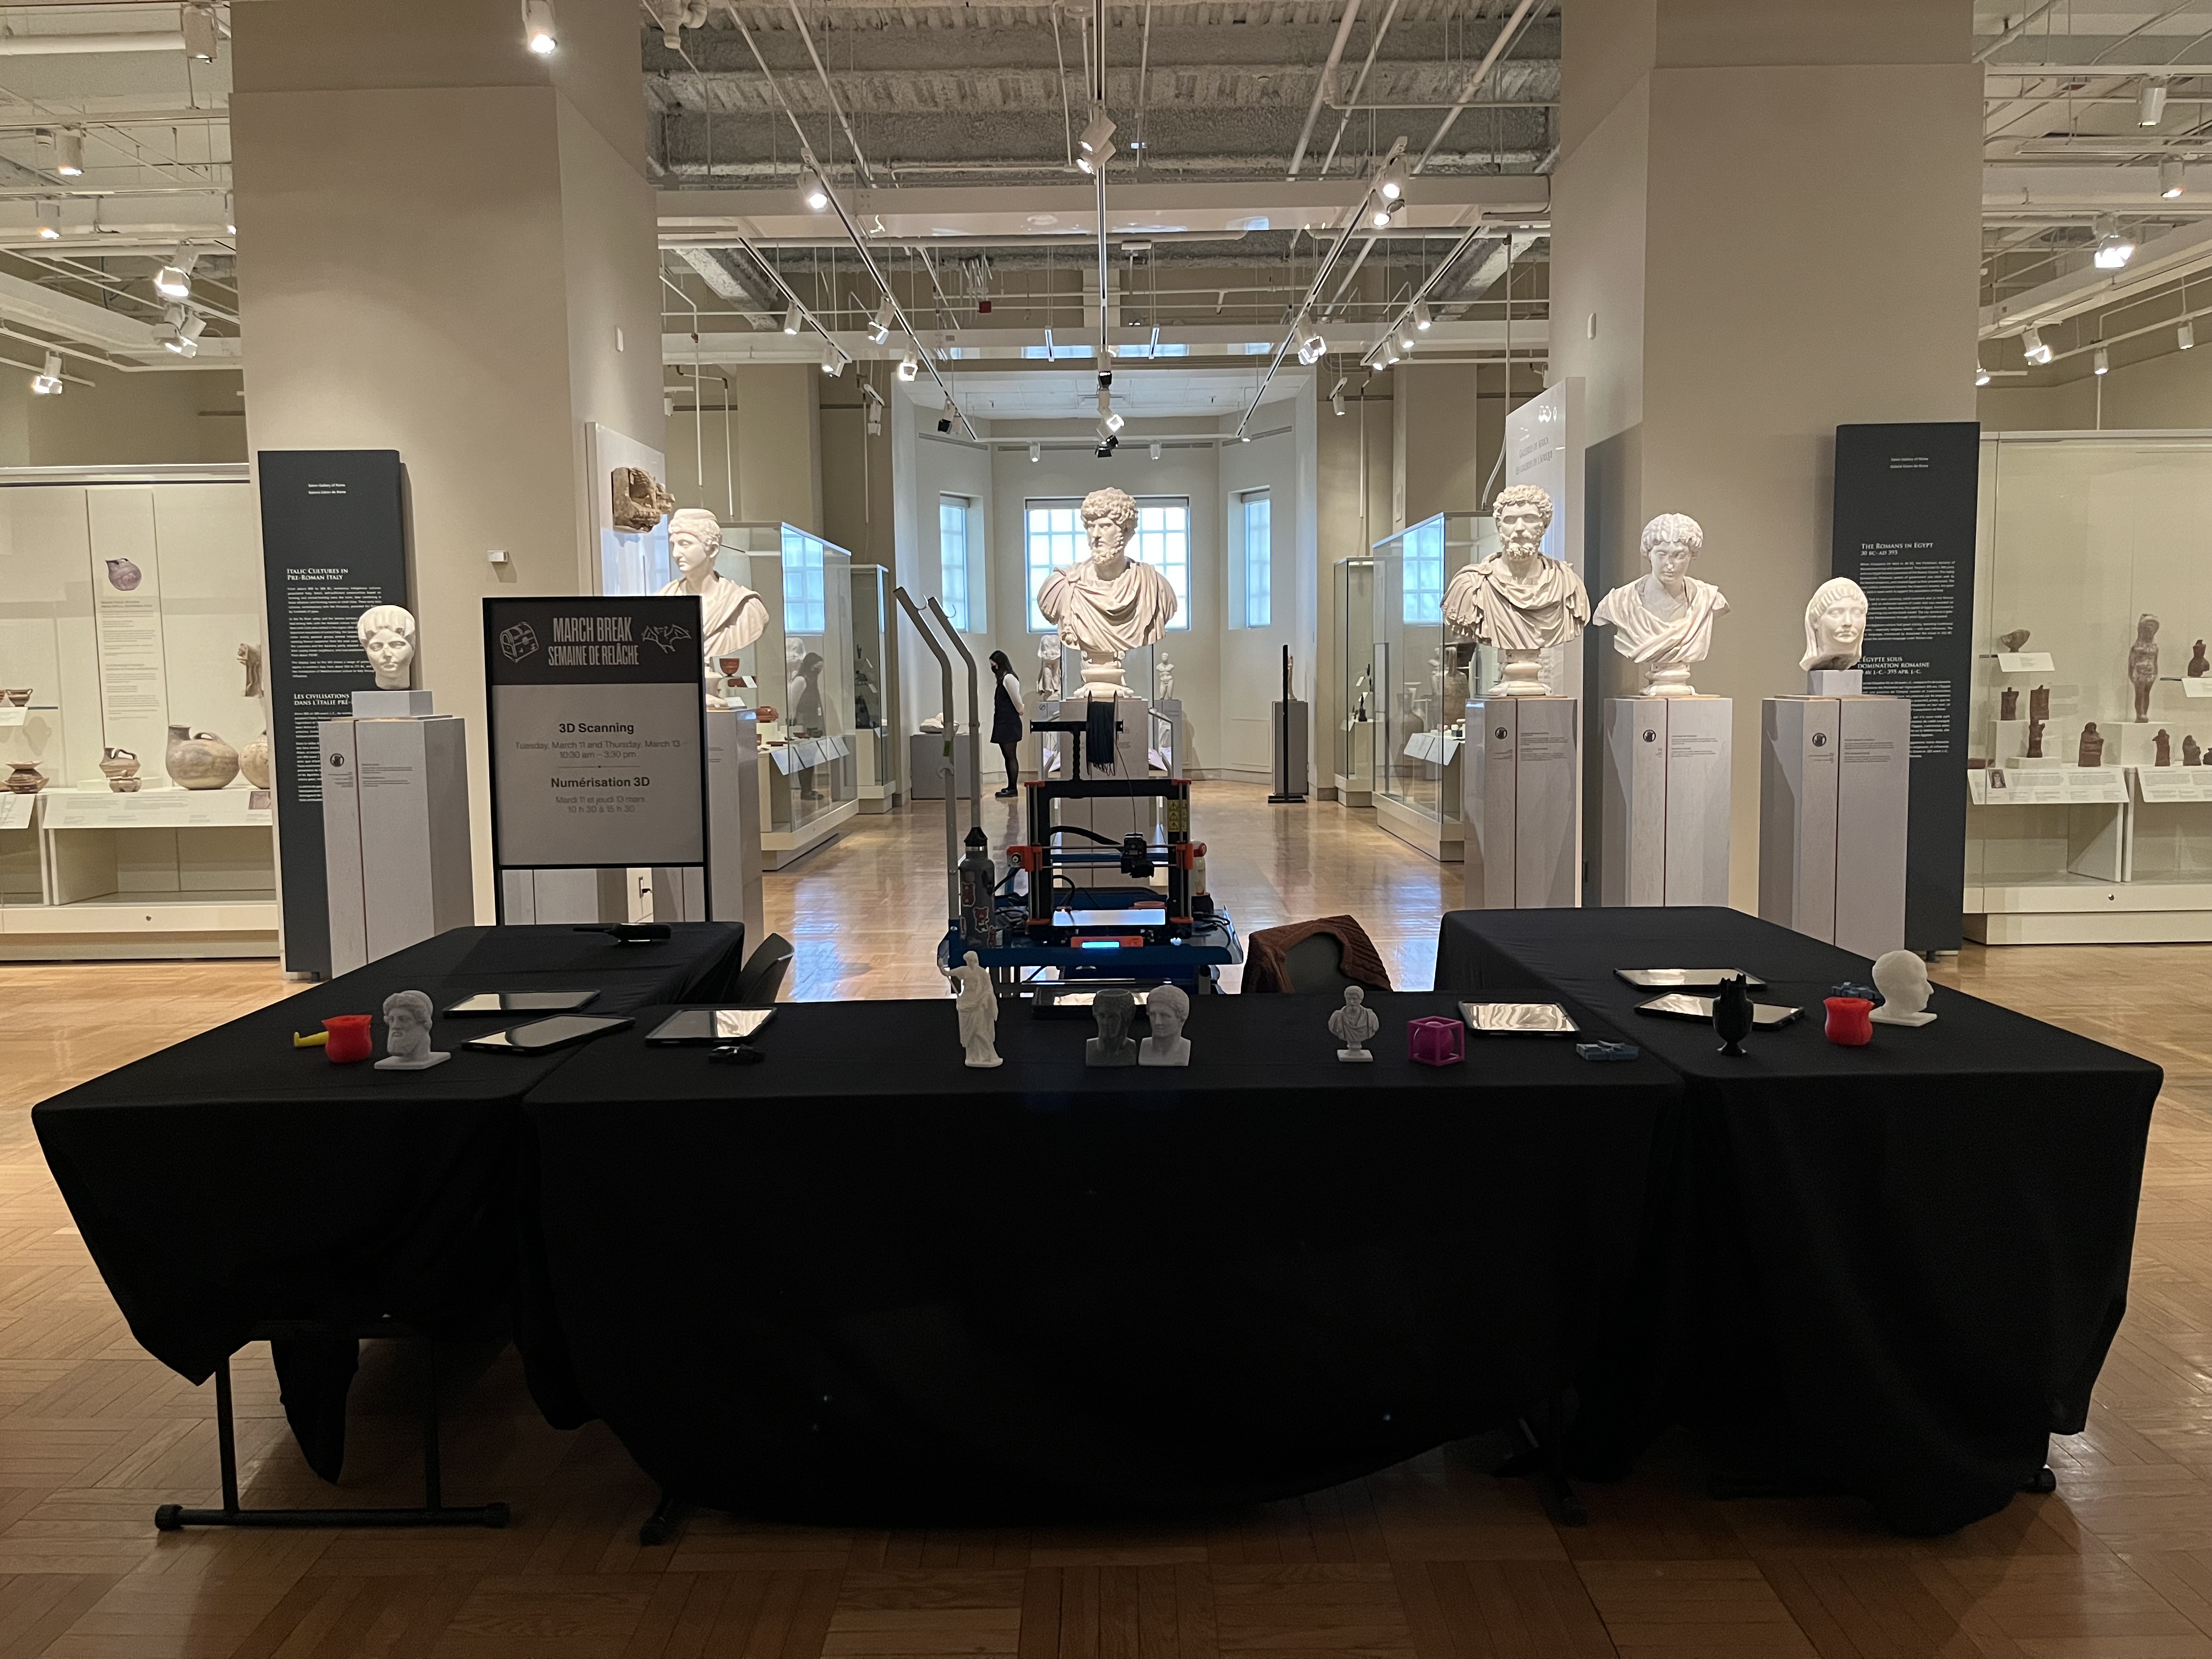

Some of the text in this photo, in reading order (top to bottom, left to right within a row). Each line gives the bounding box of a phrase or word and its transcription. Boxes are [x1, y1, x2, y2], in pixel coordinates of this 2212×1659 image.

[553, 617, 633, 642] MARCH BREAK
[548, 642, 640, 666] SEMAINE DE RELÂCHE
[559, 723, 635, 735] 3D Scanning
[551, 777, 650, 787] Numérisation 3D
[596, 796, 615, 805] jeudi
